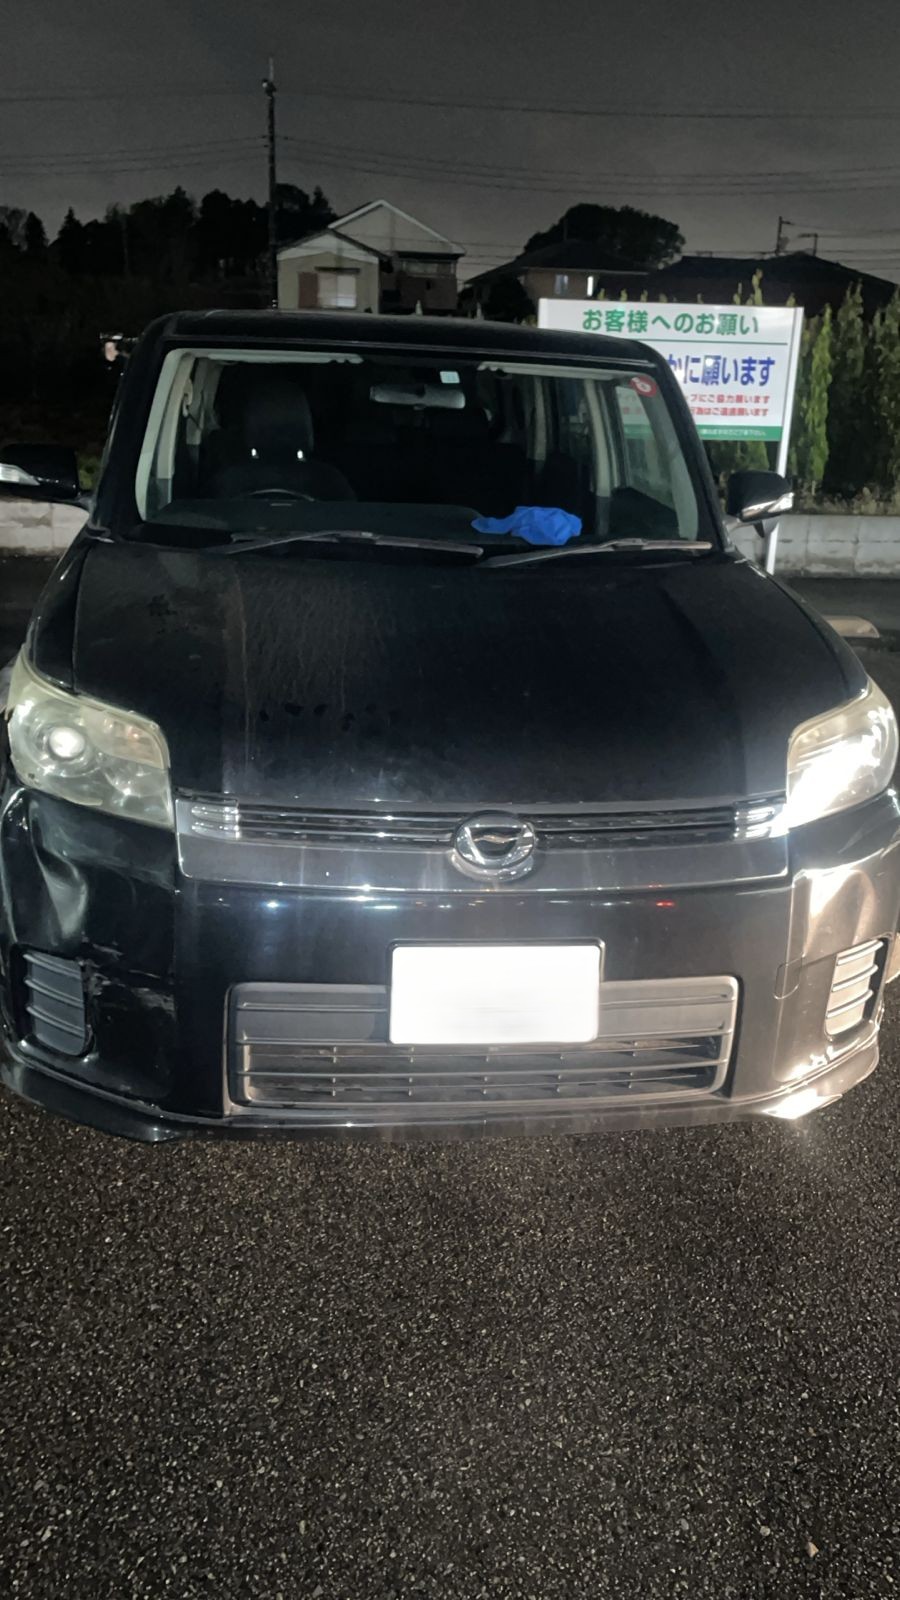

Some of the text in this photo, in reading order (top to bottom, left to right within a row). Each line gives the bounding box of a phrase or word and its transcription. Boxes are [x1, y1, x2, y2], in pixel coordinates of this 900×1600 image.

[582, 309, 759, 336] お客様へのお願い
